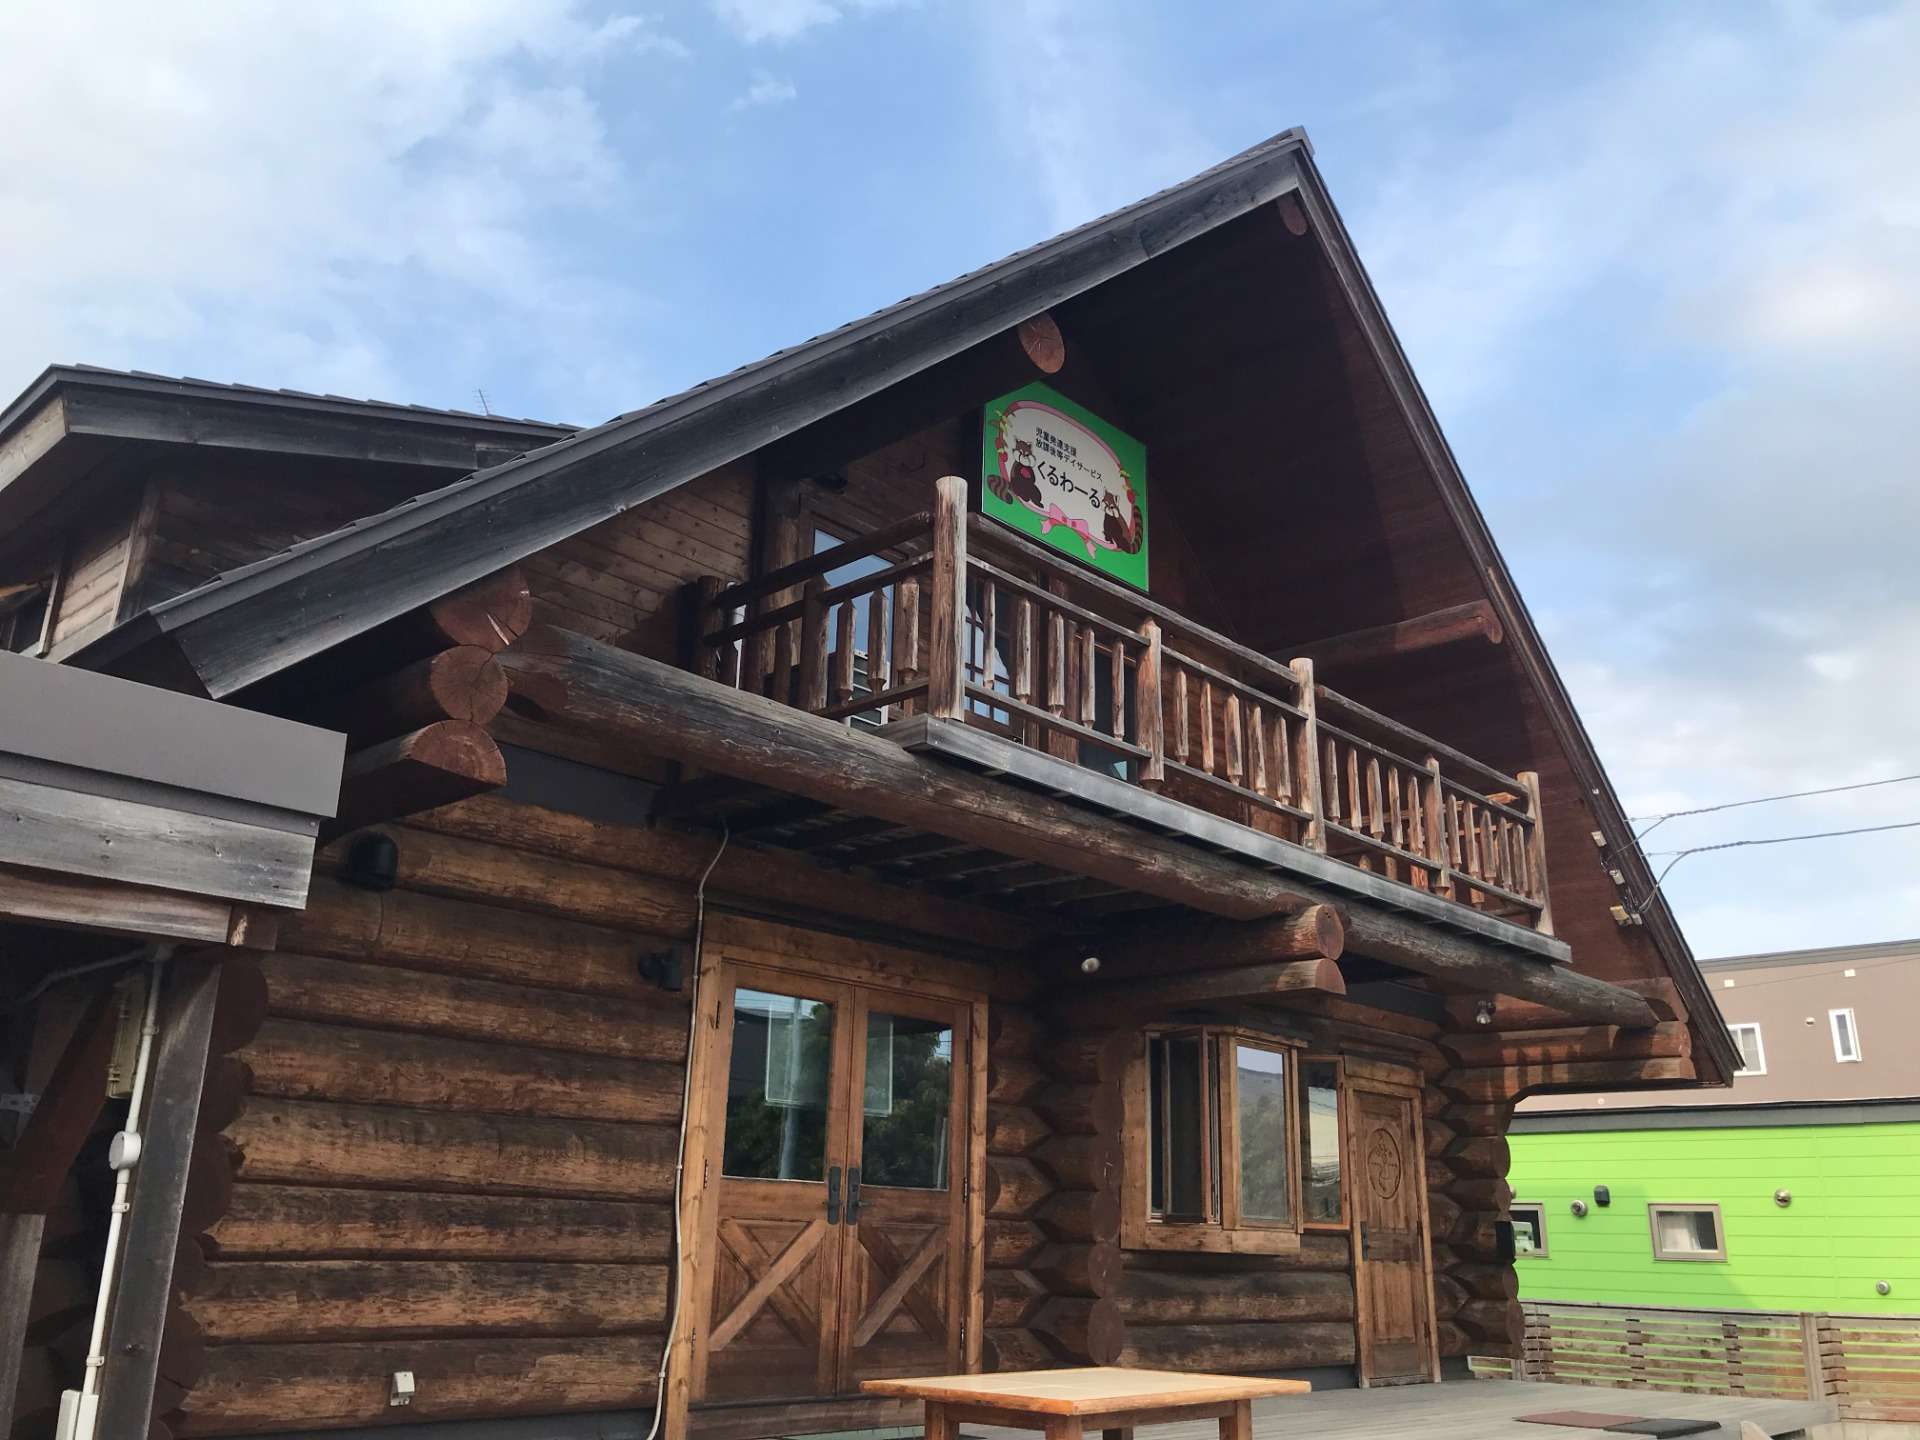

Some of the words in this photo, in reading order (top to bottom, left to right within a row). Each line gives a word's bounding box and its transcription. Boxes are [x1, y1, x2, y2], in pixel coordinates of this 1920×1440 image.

[1037, 461, 1101, 509] くるわーる
